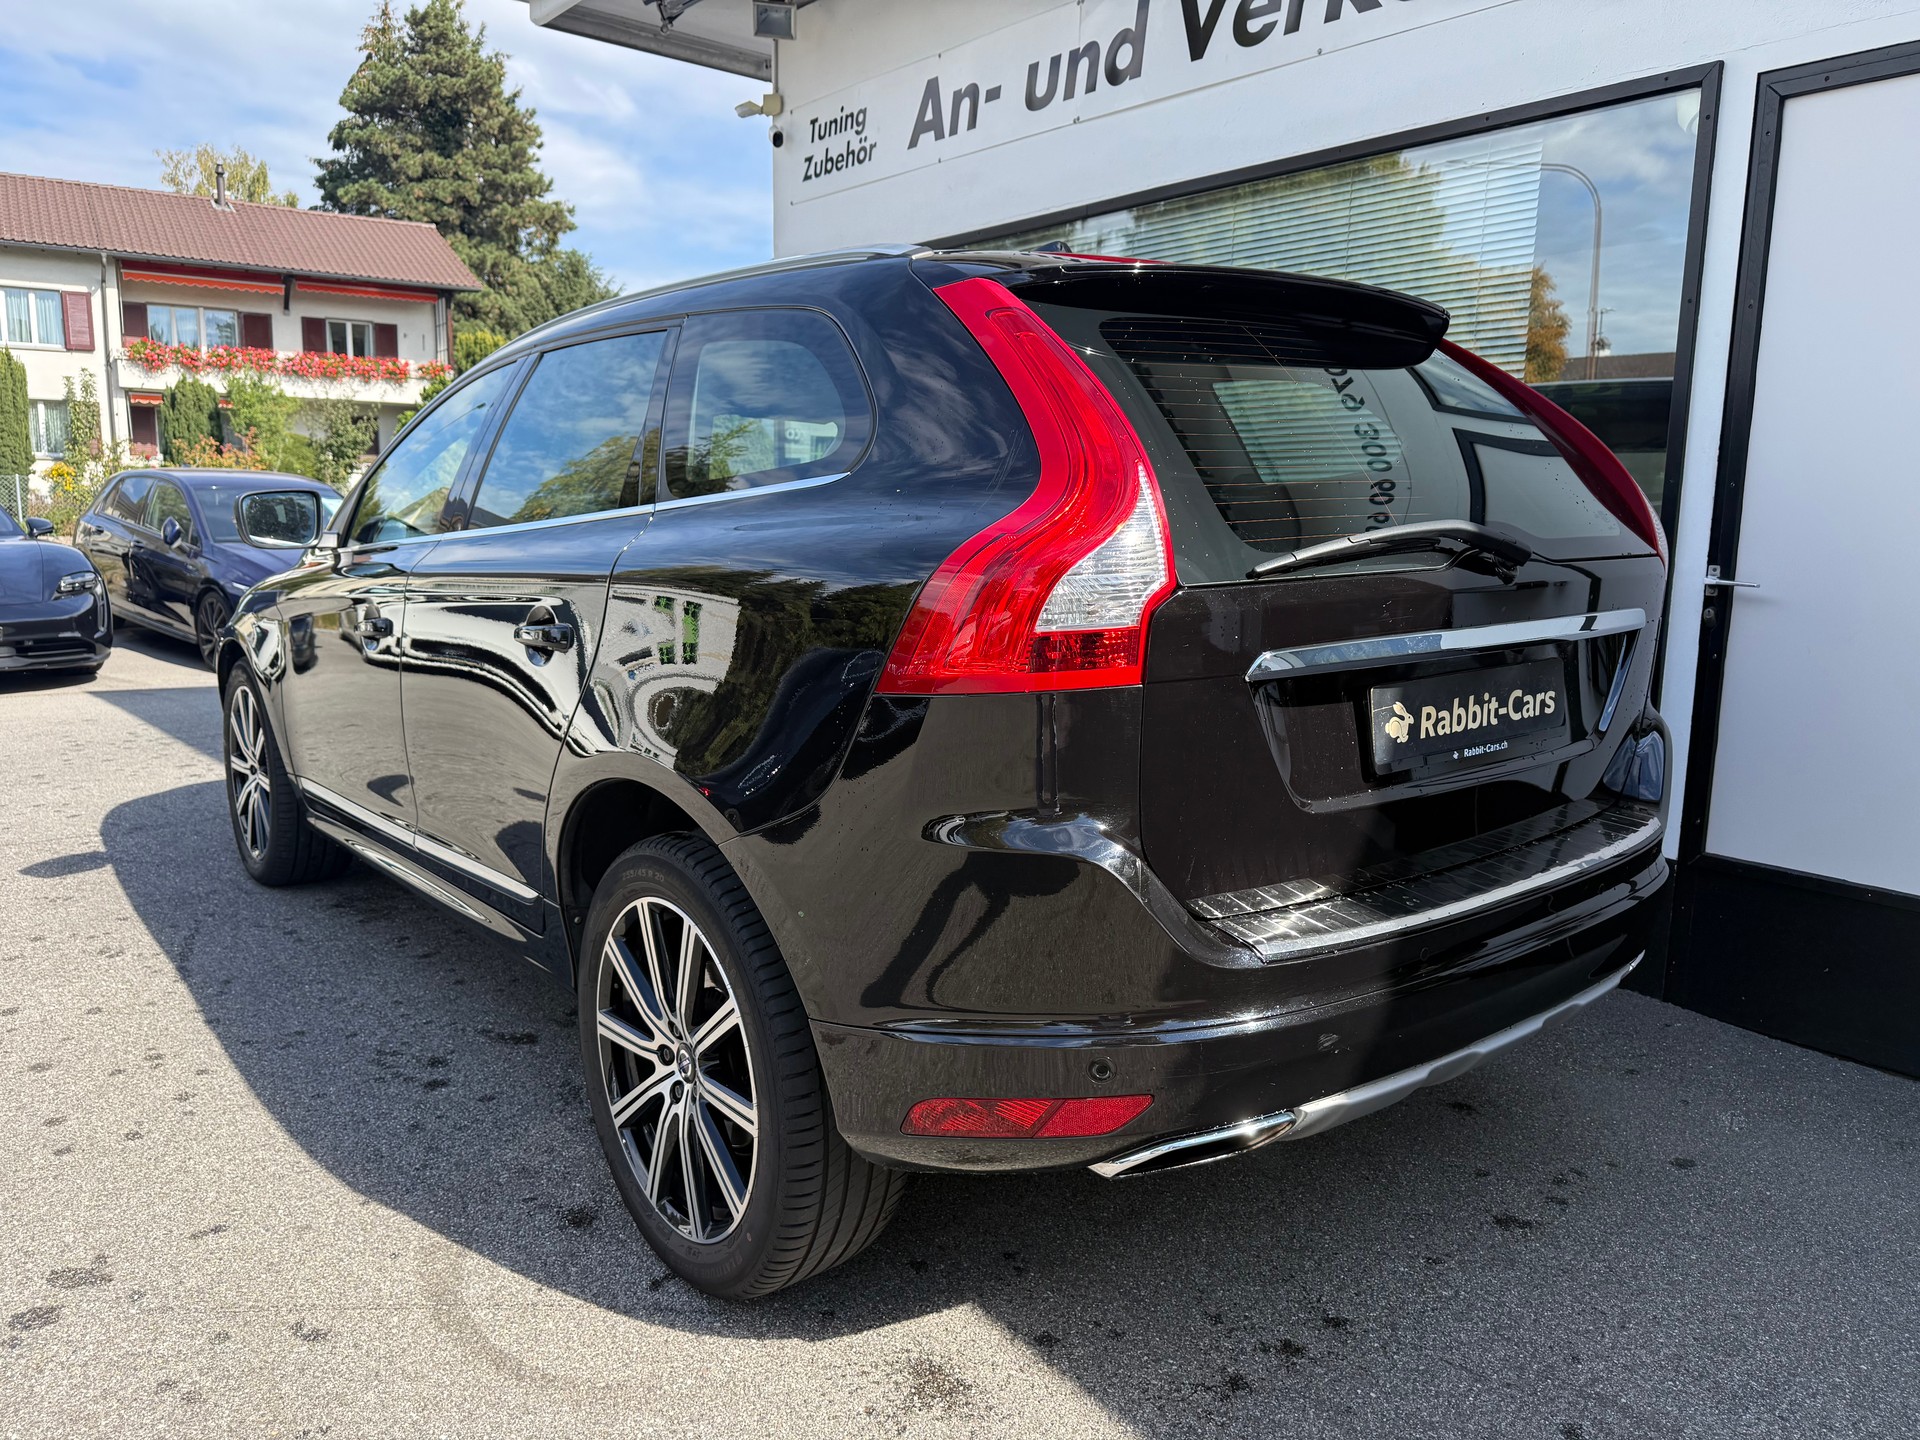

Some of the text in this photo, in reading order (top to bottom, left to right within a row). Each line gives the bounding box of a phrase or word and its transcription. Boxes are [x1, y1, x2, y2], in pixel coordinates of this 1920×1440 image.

[907, 76, 1002, 150] An-
[1025, 0, 1150, 112] und
[810, 105, 867, 143] Tuning
[802, 136, 877, 182] Zubehör
[1420, 689, 1556, 739] Rabbit-Cars
[1463, 740, 1508, 758] Rabbit-Cars.ch
